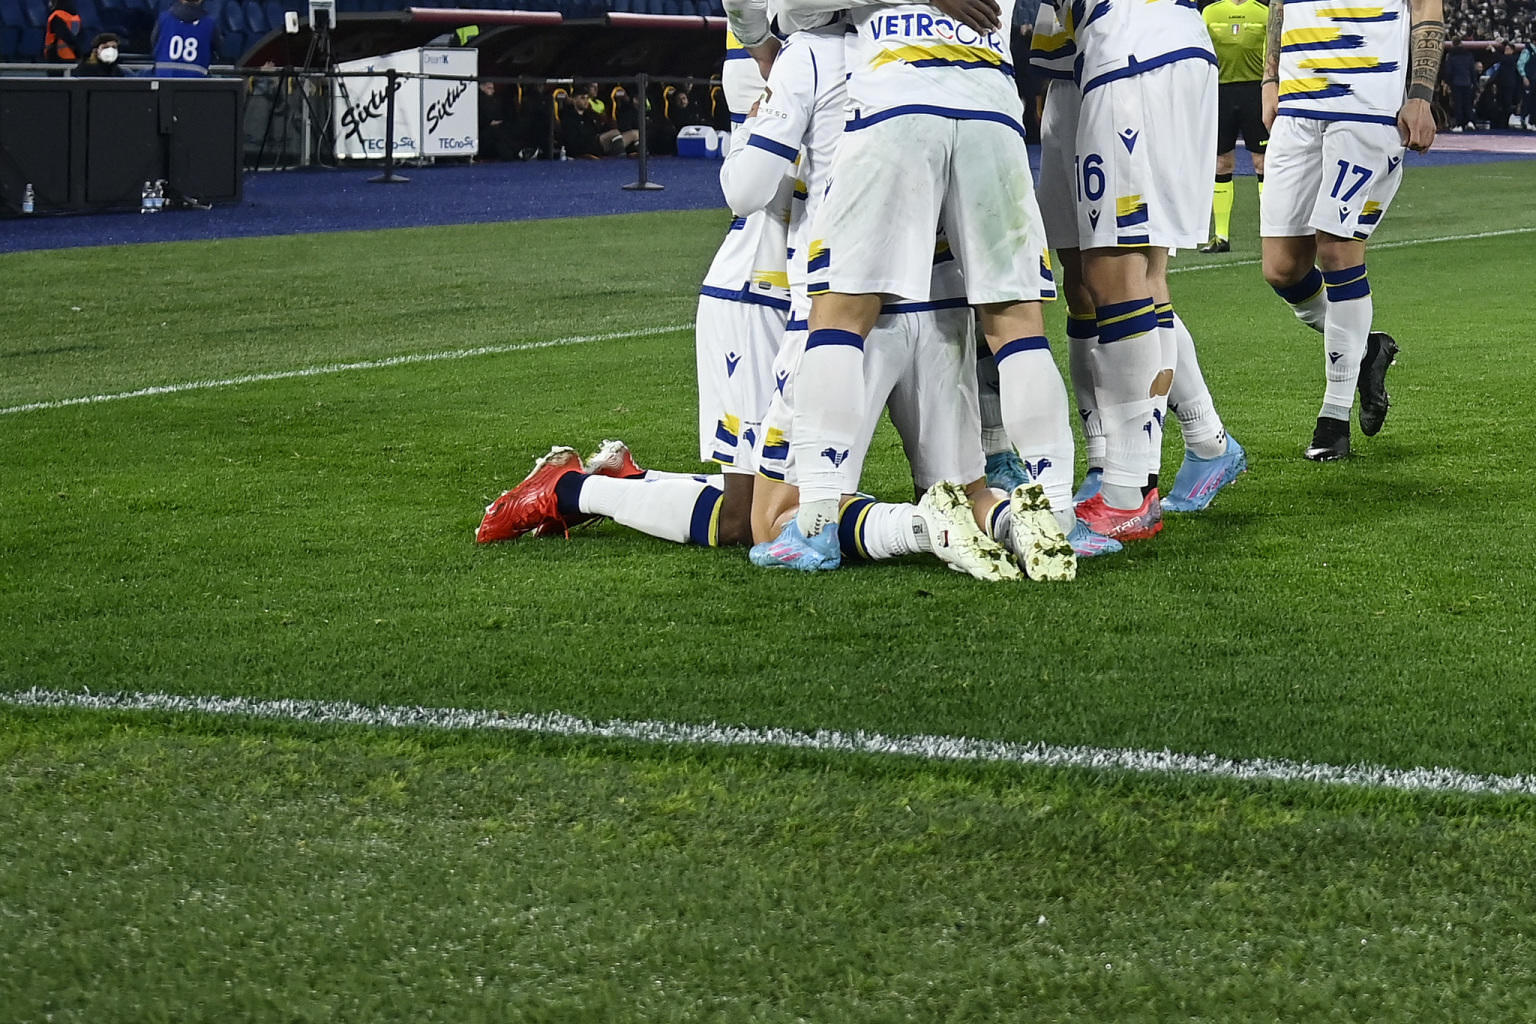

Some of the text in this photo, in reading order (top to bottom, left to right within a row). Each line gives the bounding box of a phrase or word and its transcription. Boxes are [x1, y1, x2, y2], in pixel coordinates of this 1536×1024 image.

[169, 35, 198, 62] 08
[870, 13, 1004, 54] VETROCR
[1075, 153, 1106, 203] 16
[1329, 159, 1374, 203] 17
